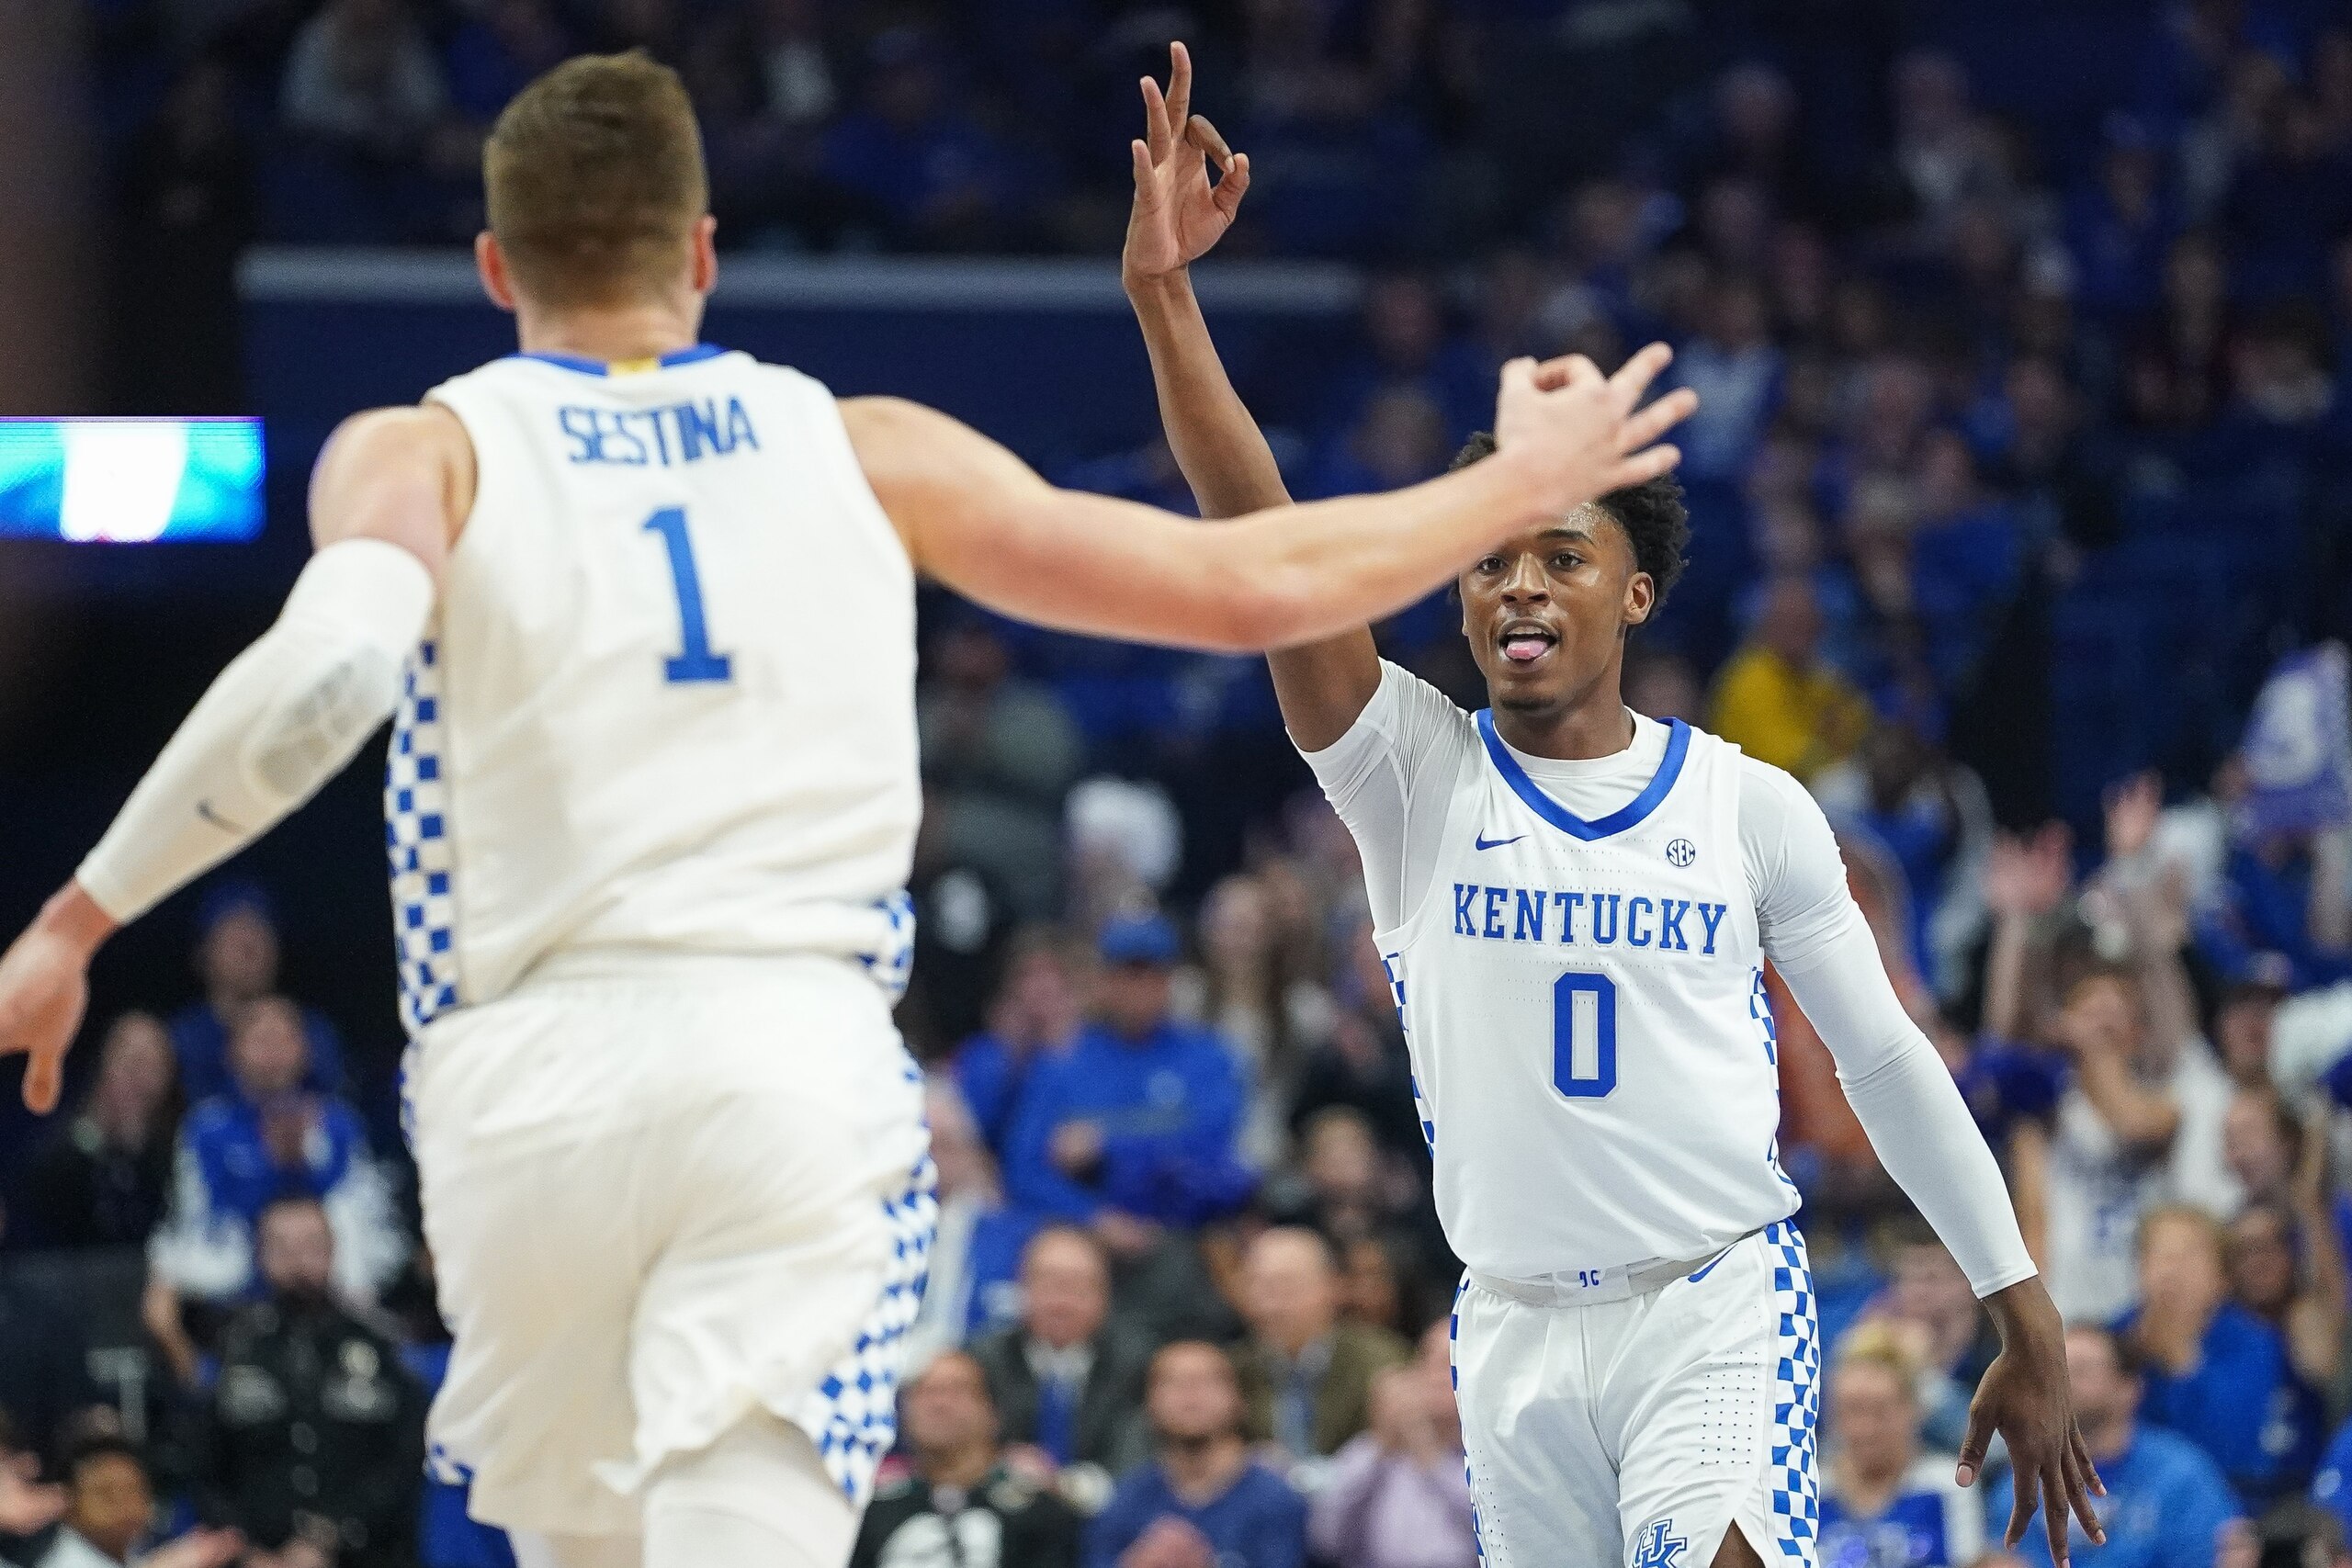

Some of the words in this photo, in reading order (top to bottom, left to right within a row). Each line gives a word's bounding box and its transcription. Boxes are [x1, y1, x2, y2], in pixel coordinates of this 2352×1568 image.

[559, 396, 761, 466] SESTINA
[644, 507, 731, 682] 1
[1667, 839, 1696, 867] SEC
[1453, 883, 1727, 954] KENTUCKY
[1554, 972, 1617, 1098] 0
